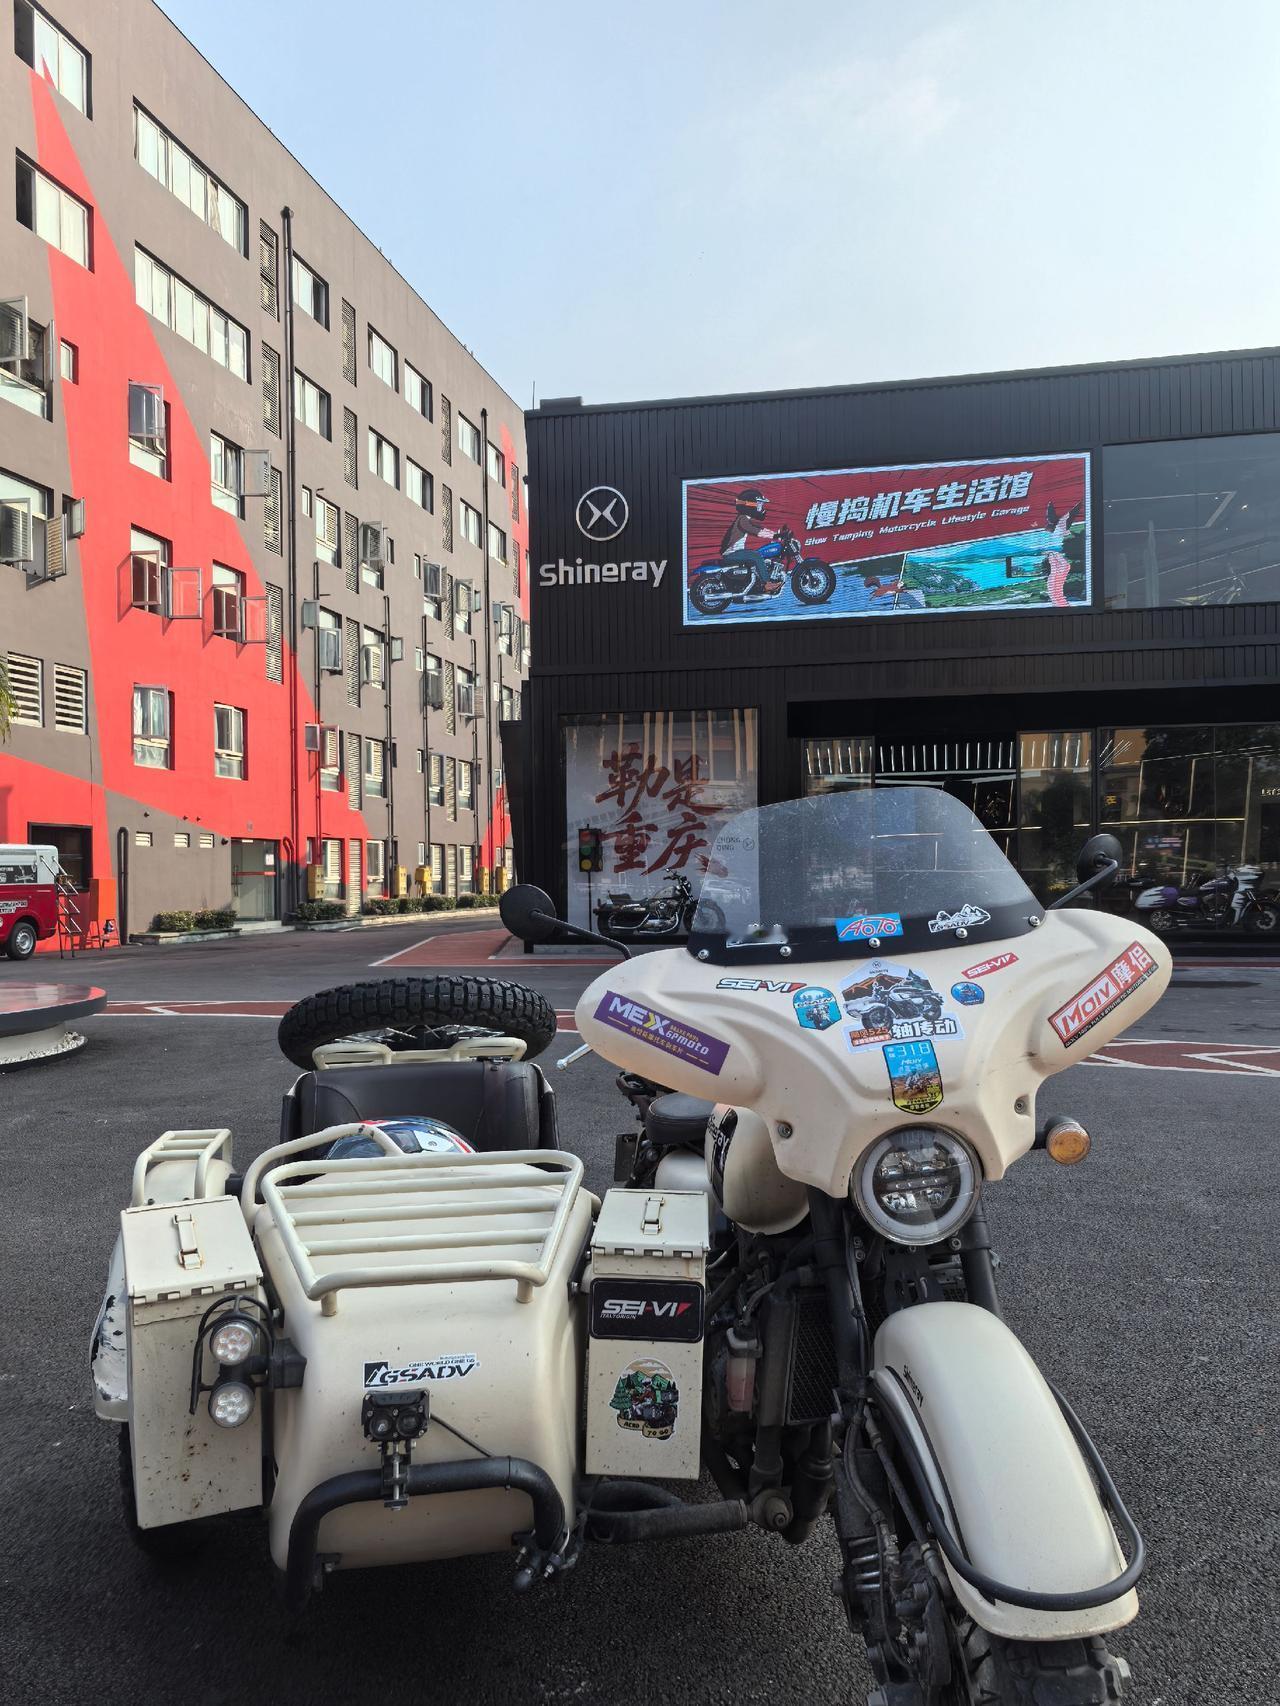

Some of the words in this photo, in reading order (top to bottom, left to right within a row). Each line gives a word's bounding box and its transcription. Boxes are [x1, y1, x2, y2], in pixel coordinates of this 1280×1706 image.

[805, 471, 1034, 531] 慢捣机车生活馆
[804, 535, 828, 546] Slow
[832, 529, 874, 543] Tamping
[879, 520, 936, 535] Motorcycle
[942, 511, 987, 526] Lifestyle
[991, 505, 1030, 518] Garage
[891, 1018, 957, 1039] 轴传动
[896, 1043, 931, 1057] 318
